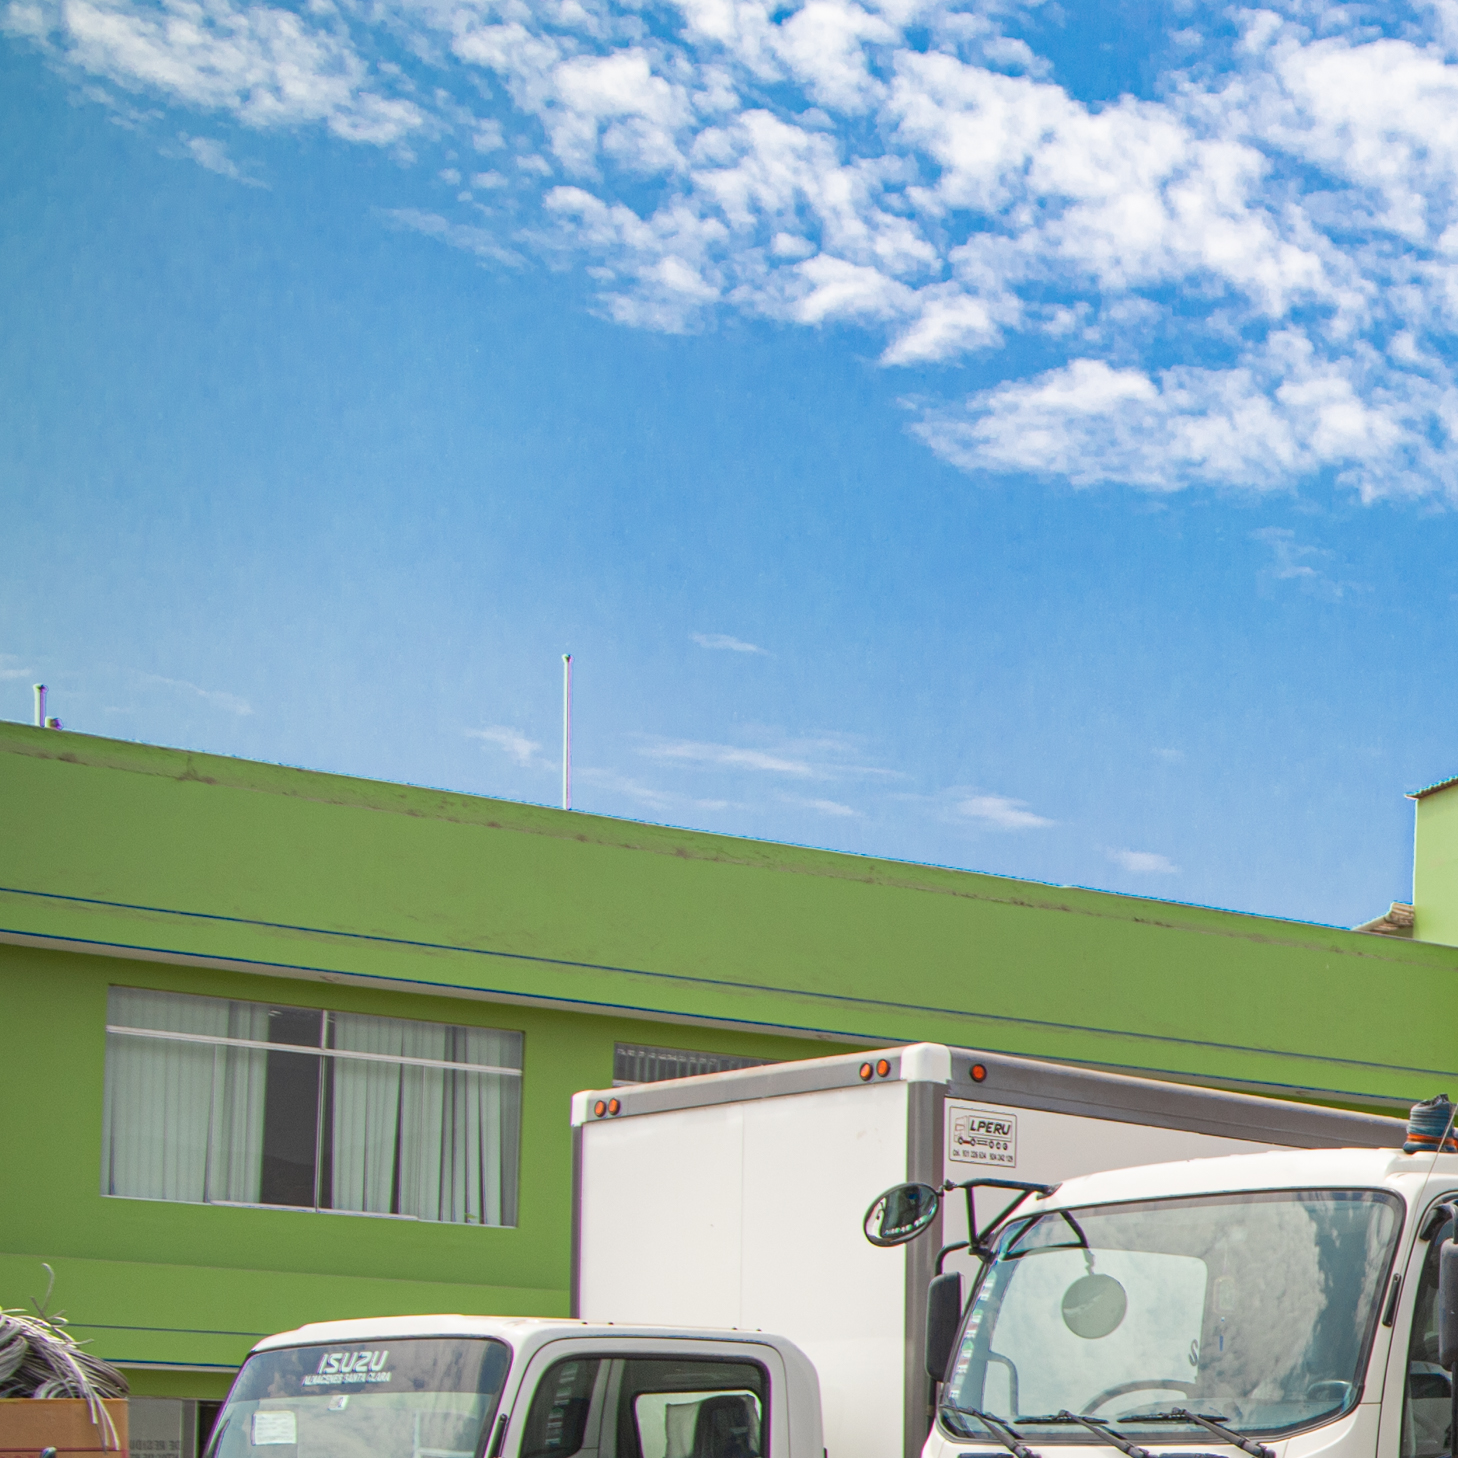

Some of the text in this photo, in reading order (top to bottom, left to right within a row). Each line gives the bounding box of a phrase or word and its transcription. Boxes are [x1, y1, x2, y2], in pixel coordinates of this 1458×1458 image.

[970, 1119, 1011, 1136] LPERU
[317, 1350, 389, 1374] ISUZU
[302, 1372, 391, 1386] ALMACENES SANTA CLARA
